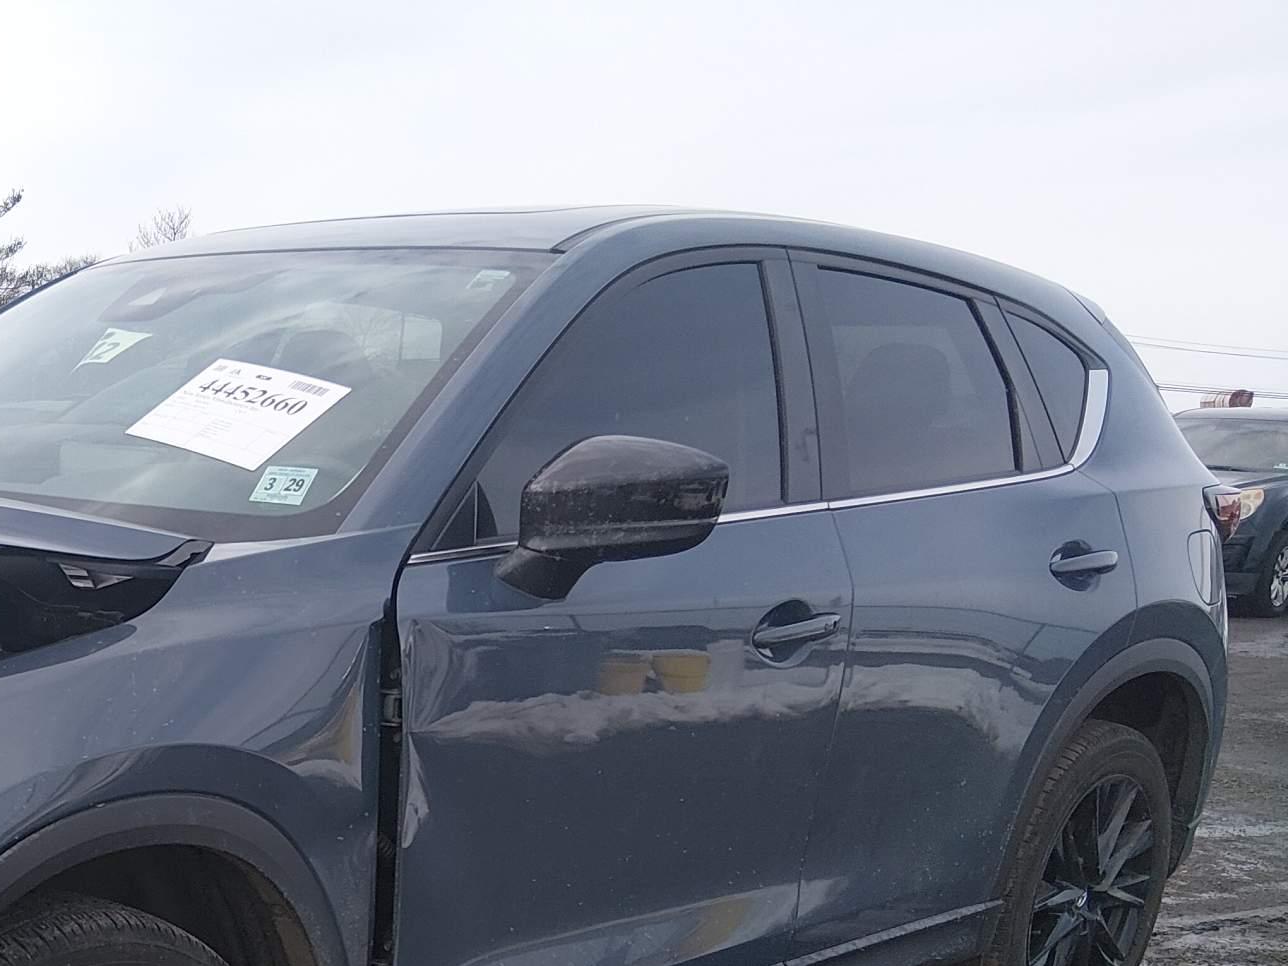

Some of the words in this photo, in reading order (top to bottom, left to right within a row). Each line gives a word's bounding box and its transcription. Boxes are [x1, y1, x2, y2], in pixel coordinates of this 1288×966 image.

[199, 379, 308, 416] 44452660
[263, 477, 277, 491] 3
[283, 478, 305, 492] 29
